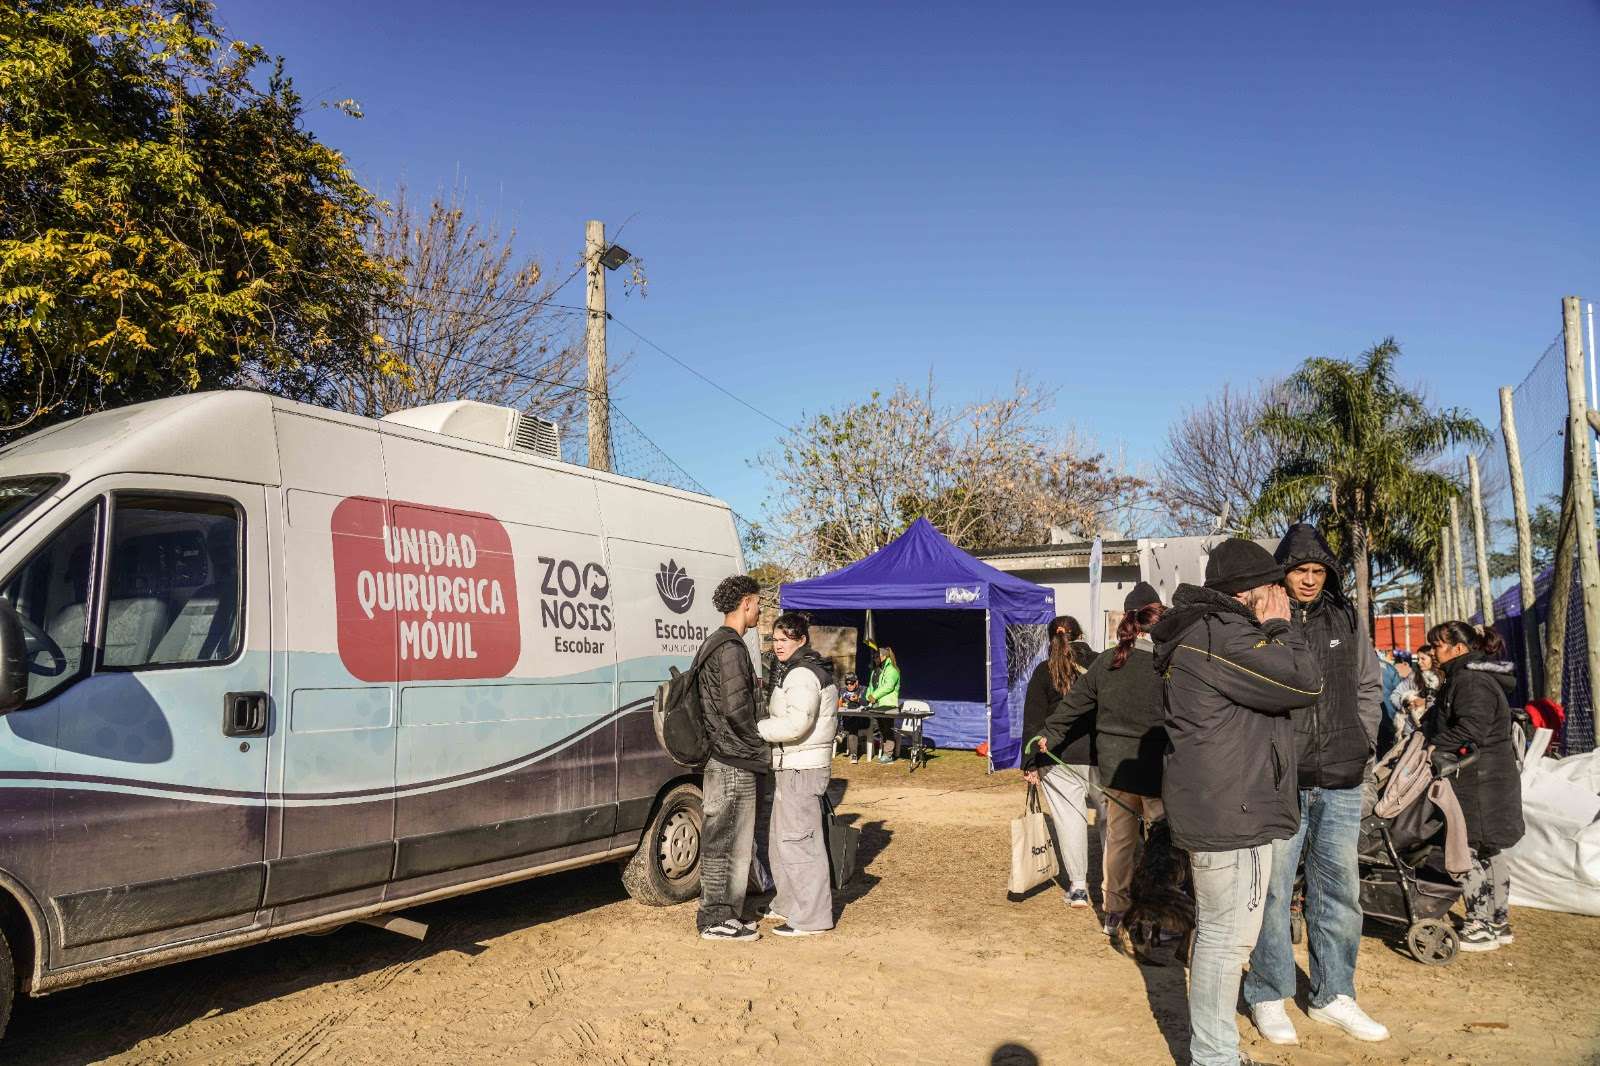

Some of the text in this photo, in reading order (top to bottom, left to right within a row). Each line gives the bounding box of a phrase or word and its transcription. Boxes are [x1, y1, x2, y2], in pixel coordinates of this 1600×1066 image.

[383, 525, 477, 573] UNIDAD
[540, 598, 612, 632] NOSIS
[655, 618, 709, 641] Escobar
[554, 636, 605, 654] Escobar
